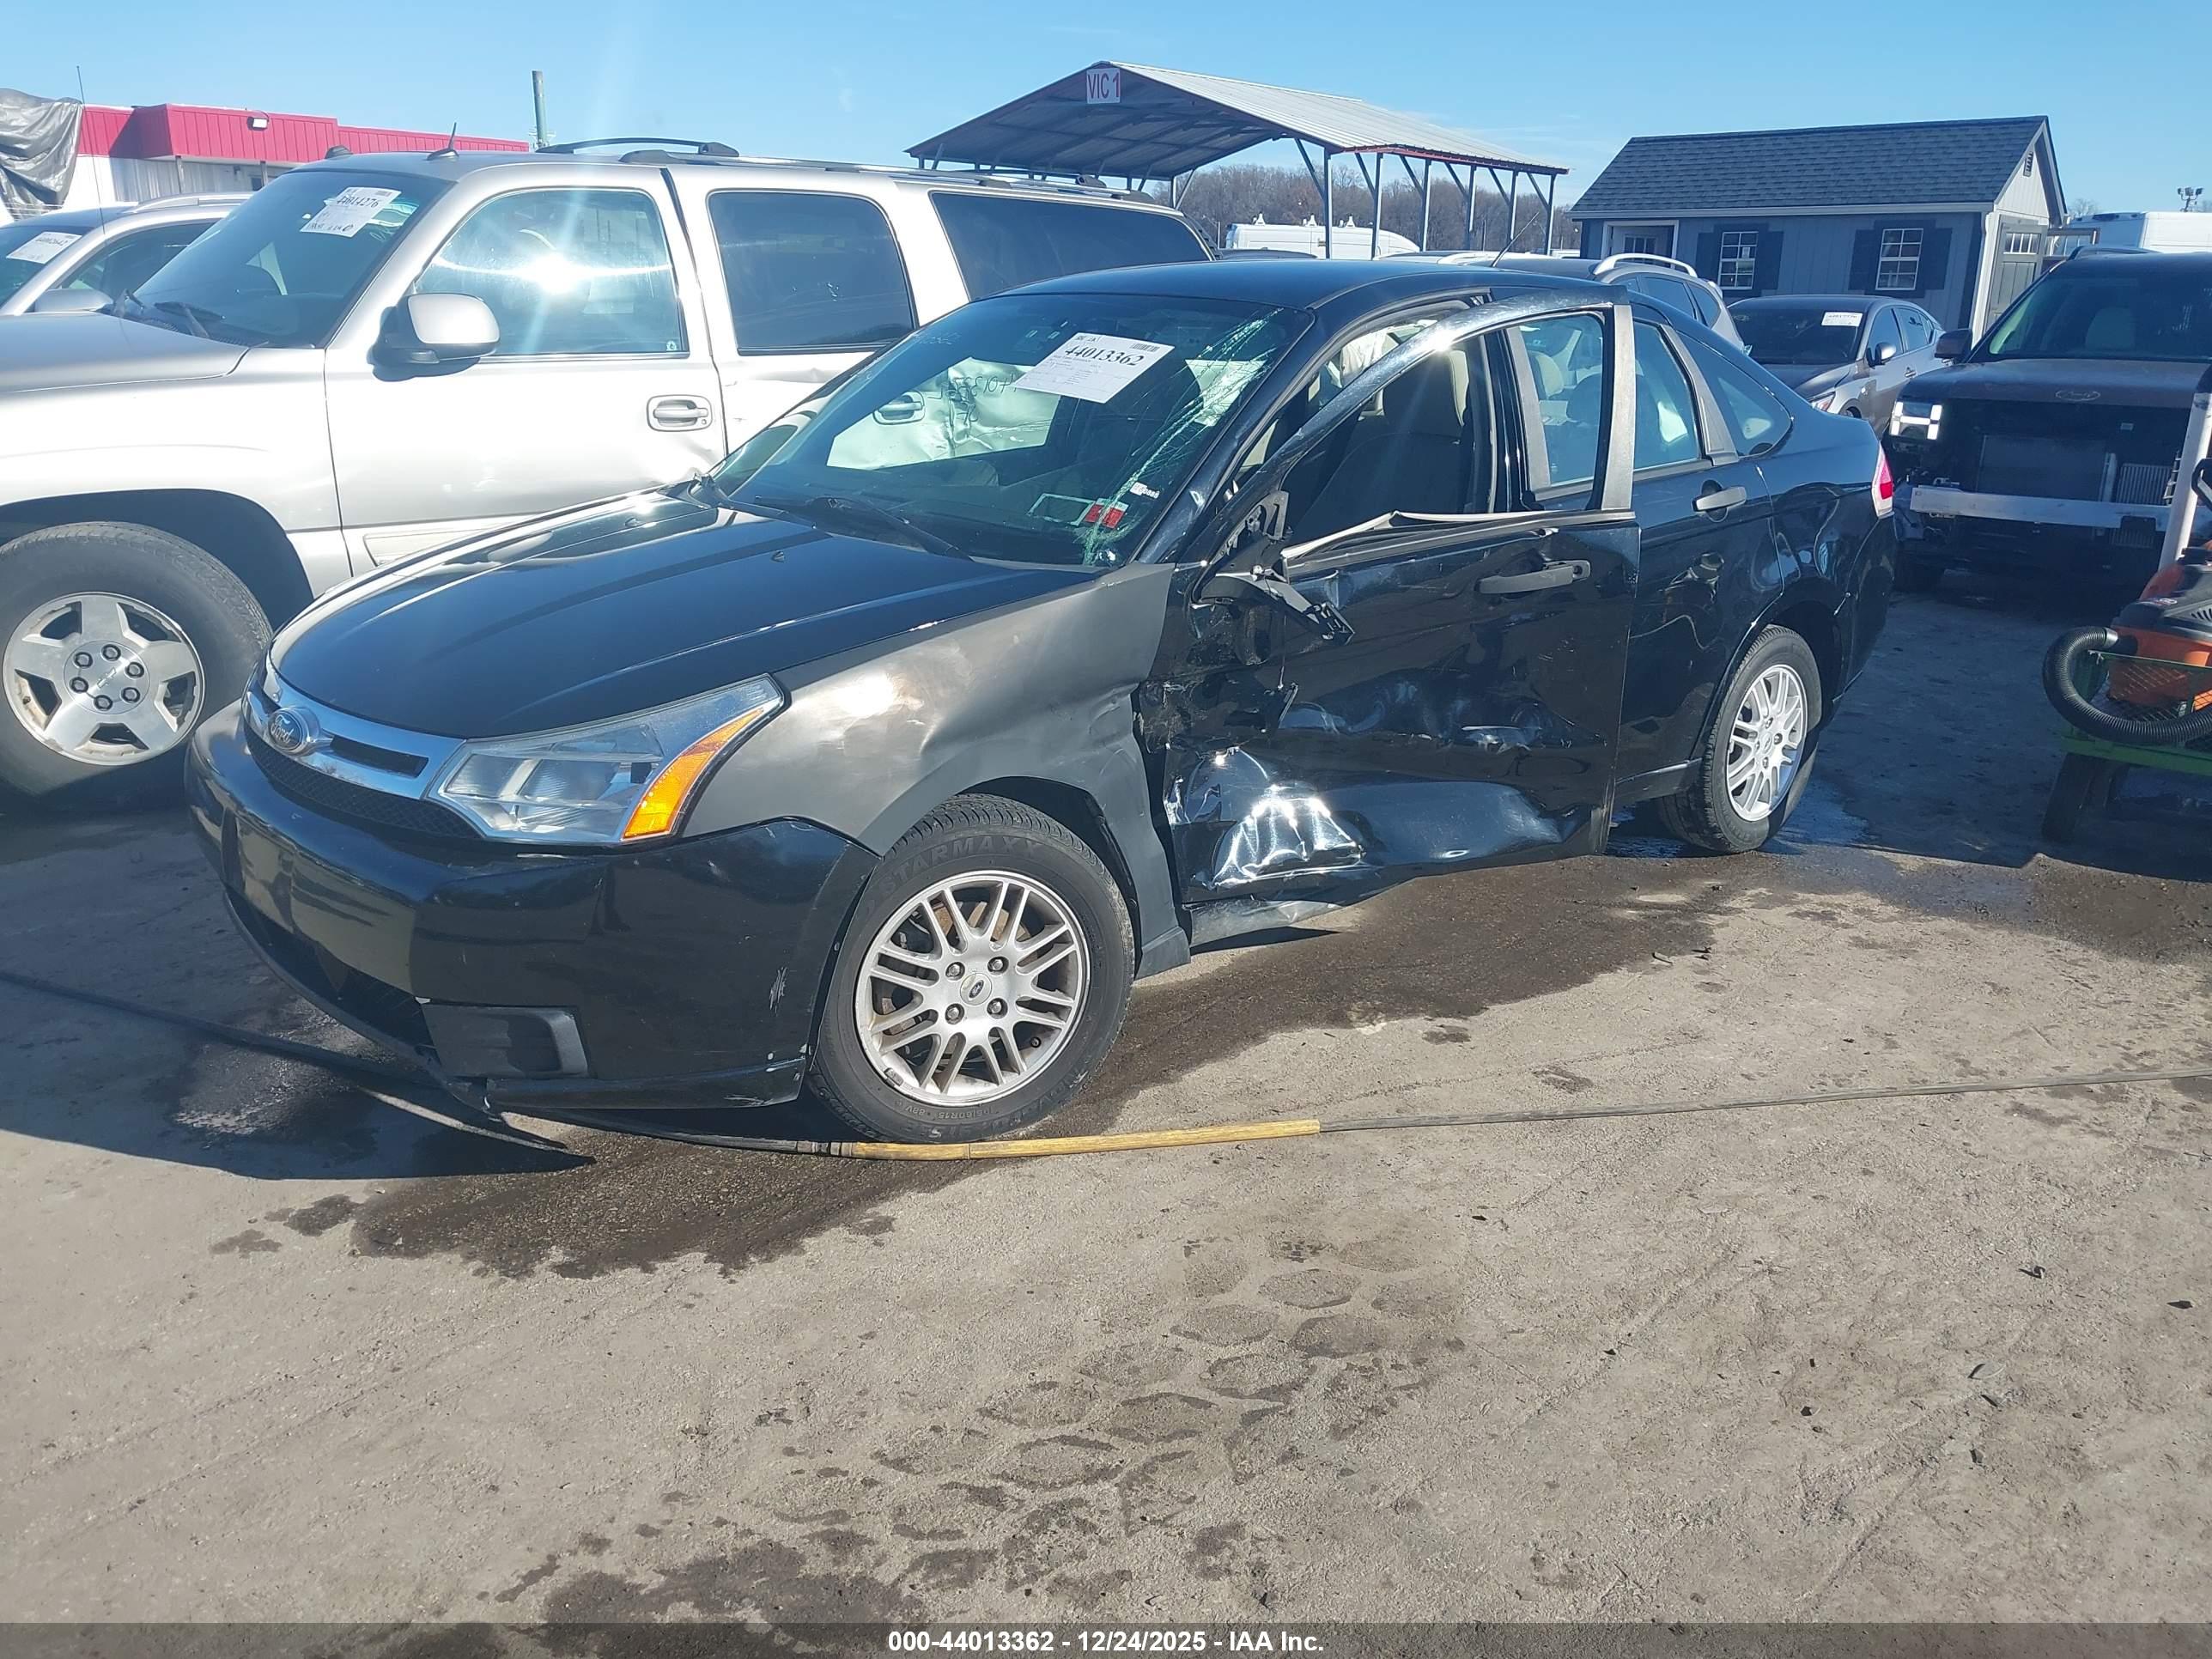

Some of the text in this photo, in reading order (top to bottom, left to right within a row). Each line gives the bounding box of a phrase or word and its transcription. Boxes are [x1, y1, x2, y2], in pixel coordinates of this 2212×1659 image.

[1087, 72, 1120, 99] VIC 1
[1065, 344, 1145, 367] 44013362
